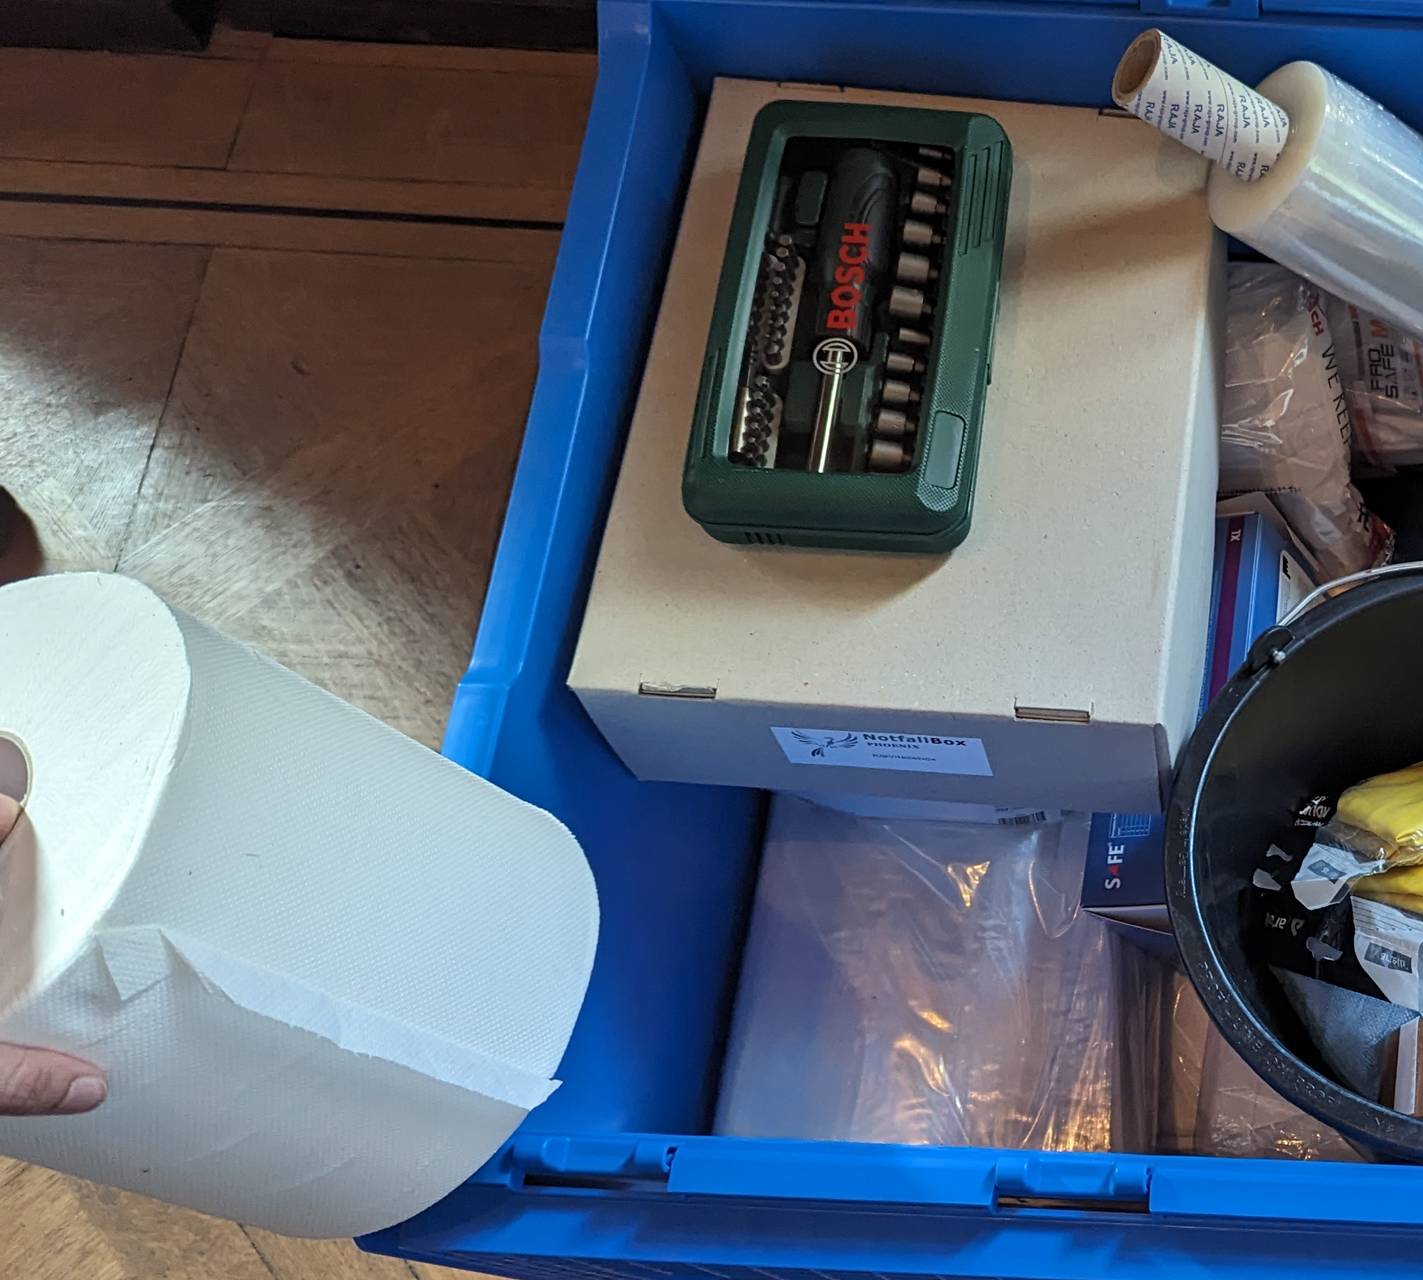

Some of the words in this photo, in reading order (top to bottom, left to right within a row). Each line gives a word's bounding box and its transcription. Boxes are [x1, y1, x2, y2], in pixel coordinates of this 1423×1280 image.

[1191, 104, 1203, 135] RAJA
[1214, 104, 1226, 137] RAJA
[1239, 95, 1251, 129] RAJA
[826, 223, 873, 331] BOSCH
[1321, 344, 1340, 390] WE
[1230, 529, 1242, 542] XL
[863, 732, 968, 748] NotfallBox
[867, 741, 920, 750] PHOENIX
